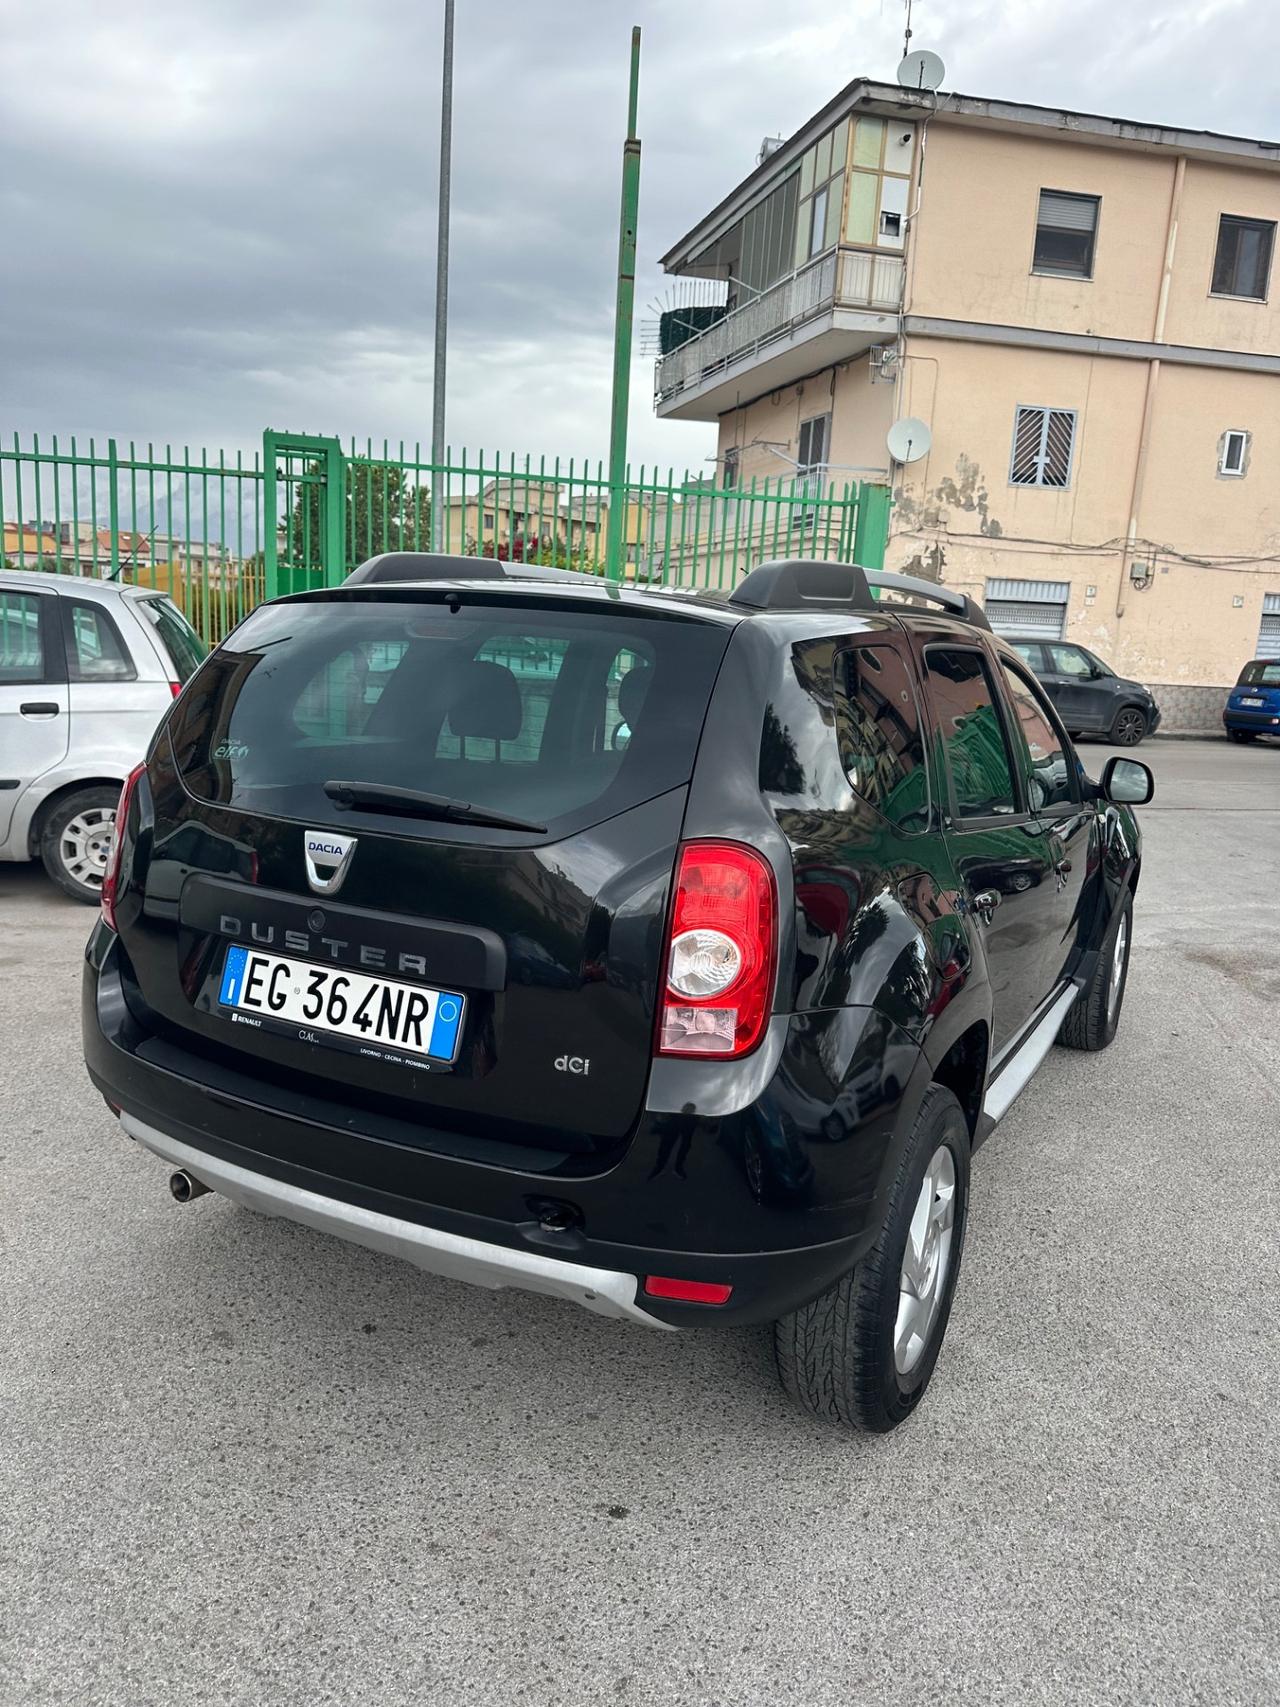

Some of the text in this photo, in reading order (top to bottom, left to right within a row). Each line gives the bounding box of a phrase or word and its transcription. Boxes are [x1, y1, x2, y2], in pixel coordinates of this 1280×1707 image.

[308, 842, 343, 855] DACIA
[220, 915, 426, 975] DUSTER
[244, 957, 291, 1011] EG
[237, 1015, 262, 1027] RENAULT
[360, 1048, 430, 1070] LIVORNO CECINA PIOMBINO
[554, 1055, 590, 1075] dCi
